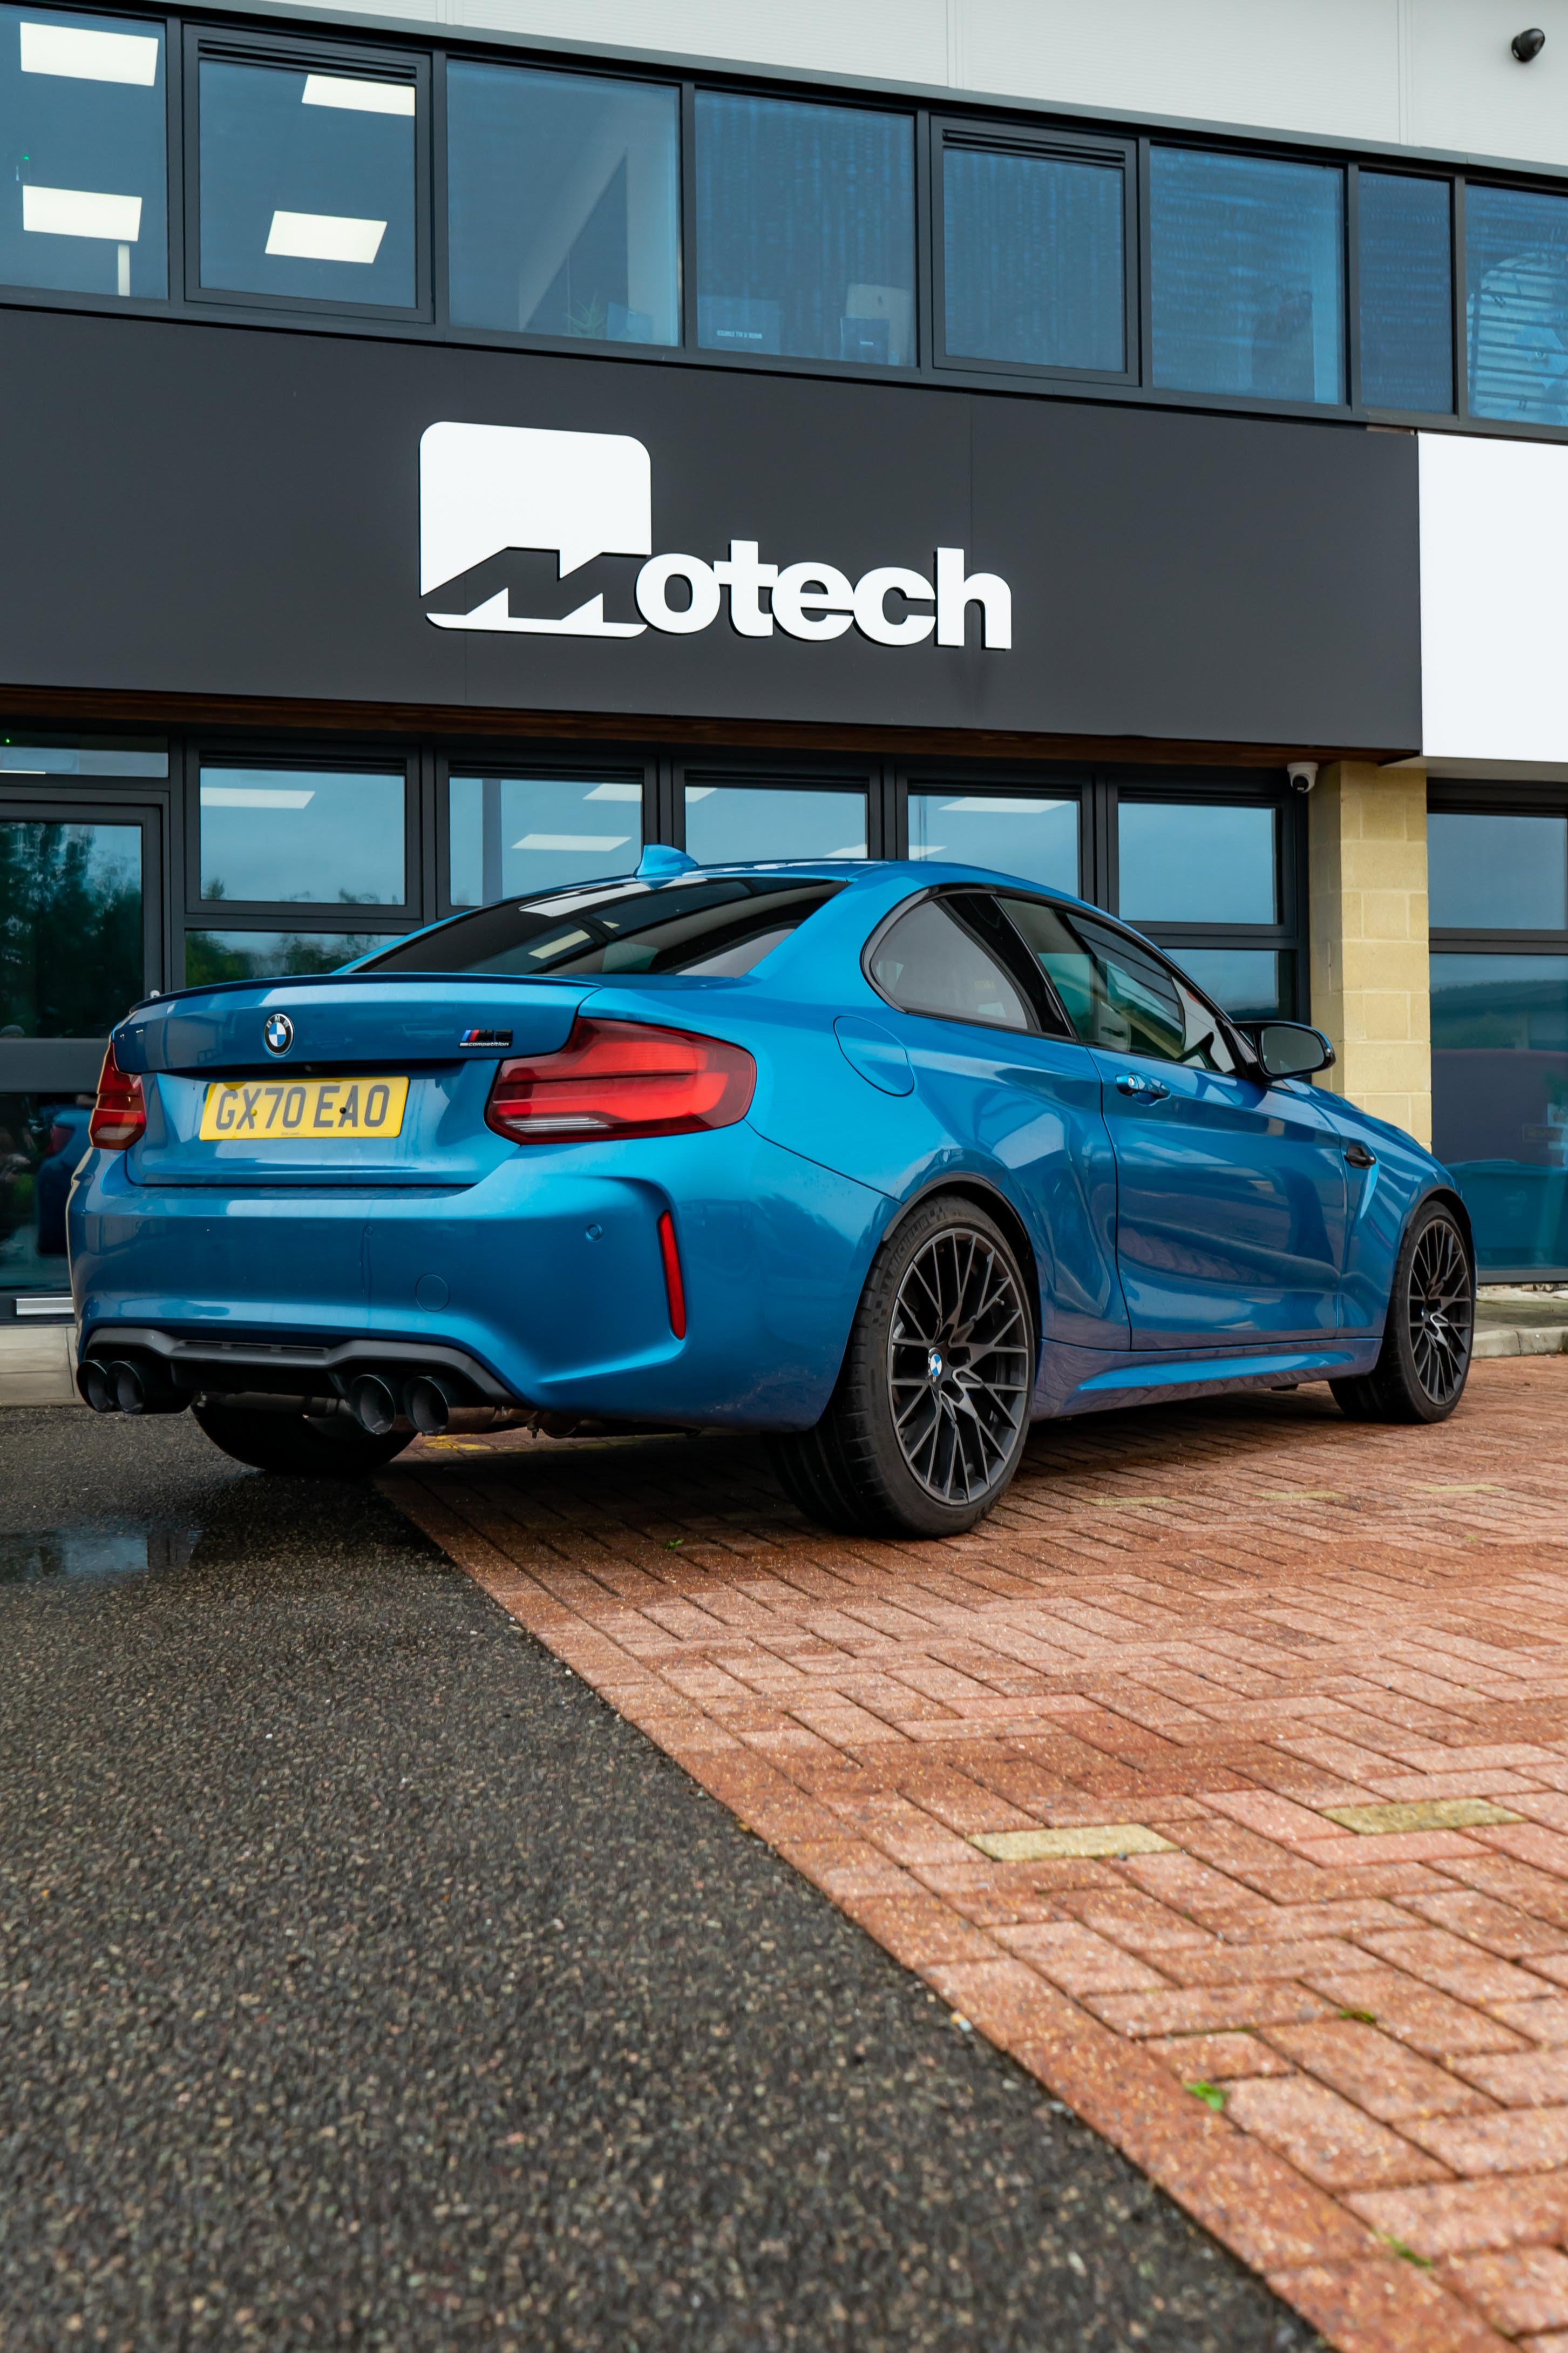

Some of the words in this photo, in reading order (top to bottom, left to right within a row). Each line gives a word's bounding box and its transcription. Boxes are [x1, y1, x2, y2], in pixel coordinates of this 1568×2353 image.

[266, 1015, 290, 1028] BMW
[216, 1086, 307, 1130] GX70
[888, 1215, 929, 1277] MICHELIN
